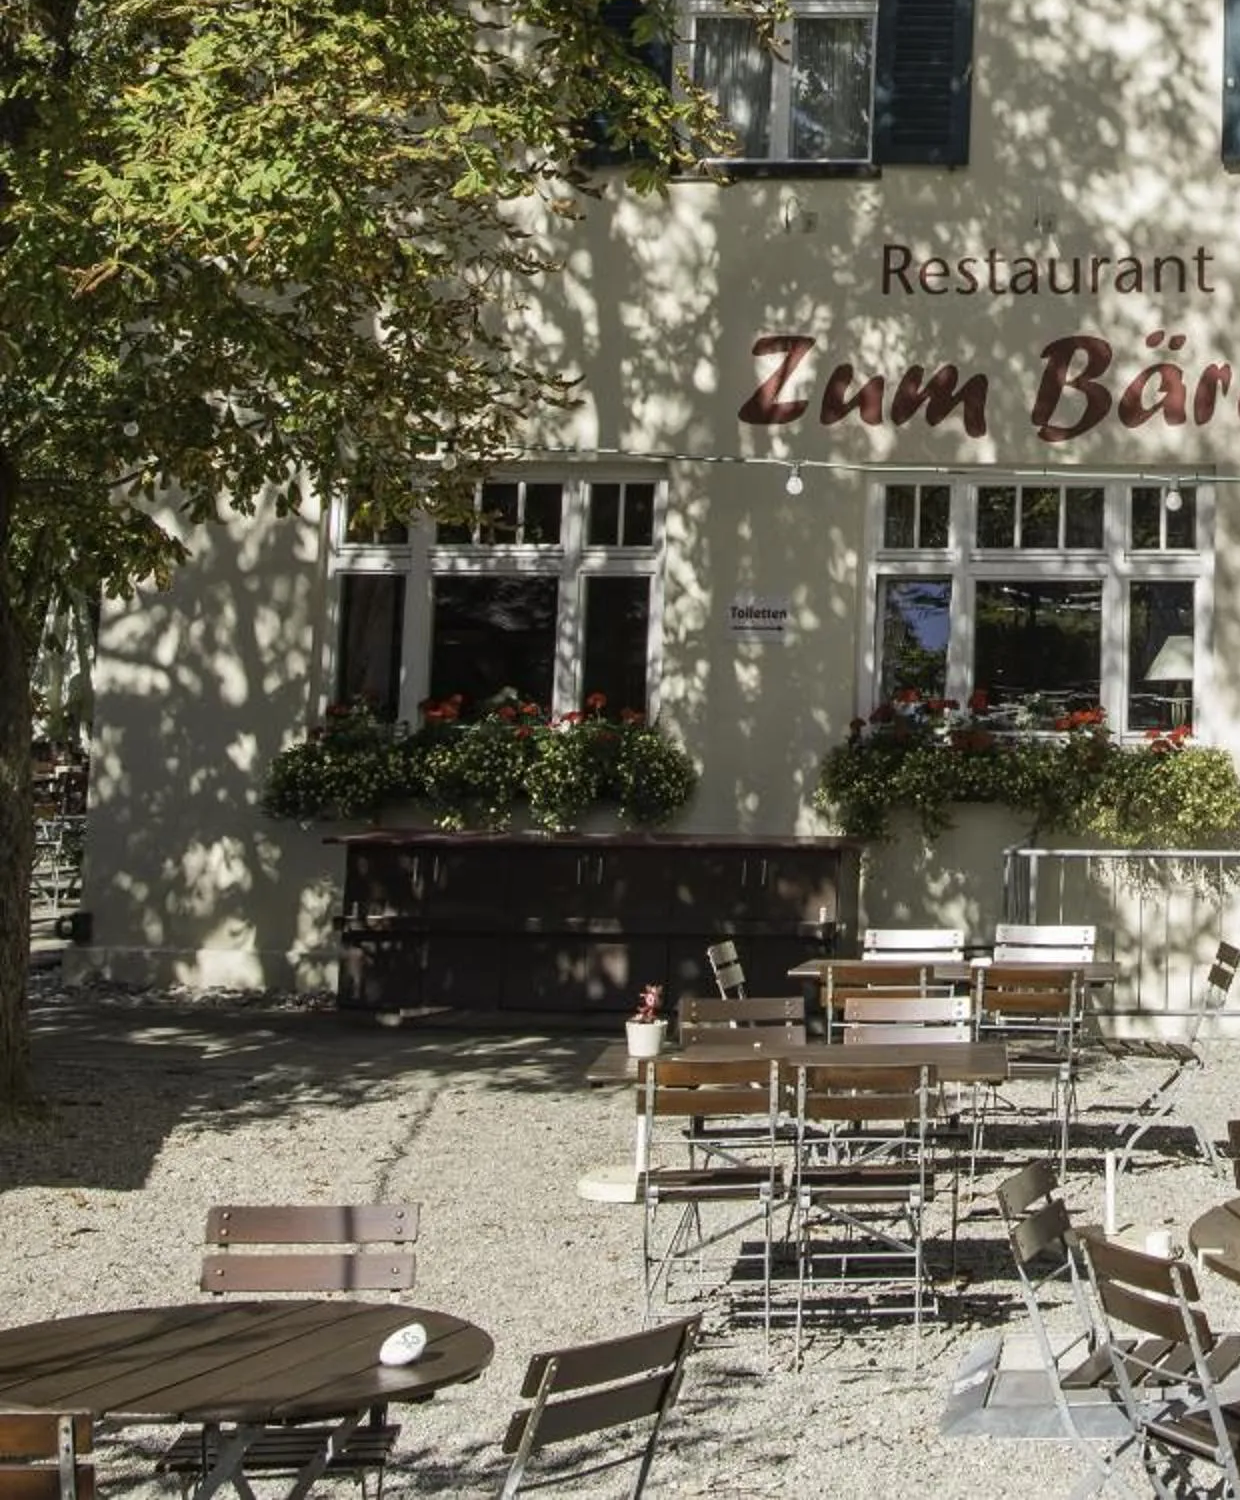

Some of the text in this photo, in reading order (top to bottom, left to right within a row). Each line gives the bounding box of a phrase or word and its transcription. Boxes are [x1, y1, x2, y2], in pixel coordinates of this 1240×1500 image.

[882, 245, 1215, 296] Restaurant
[738, 336, 988, 440] Zum
[730, 606, 787, 619] Toiletten
